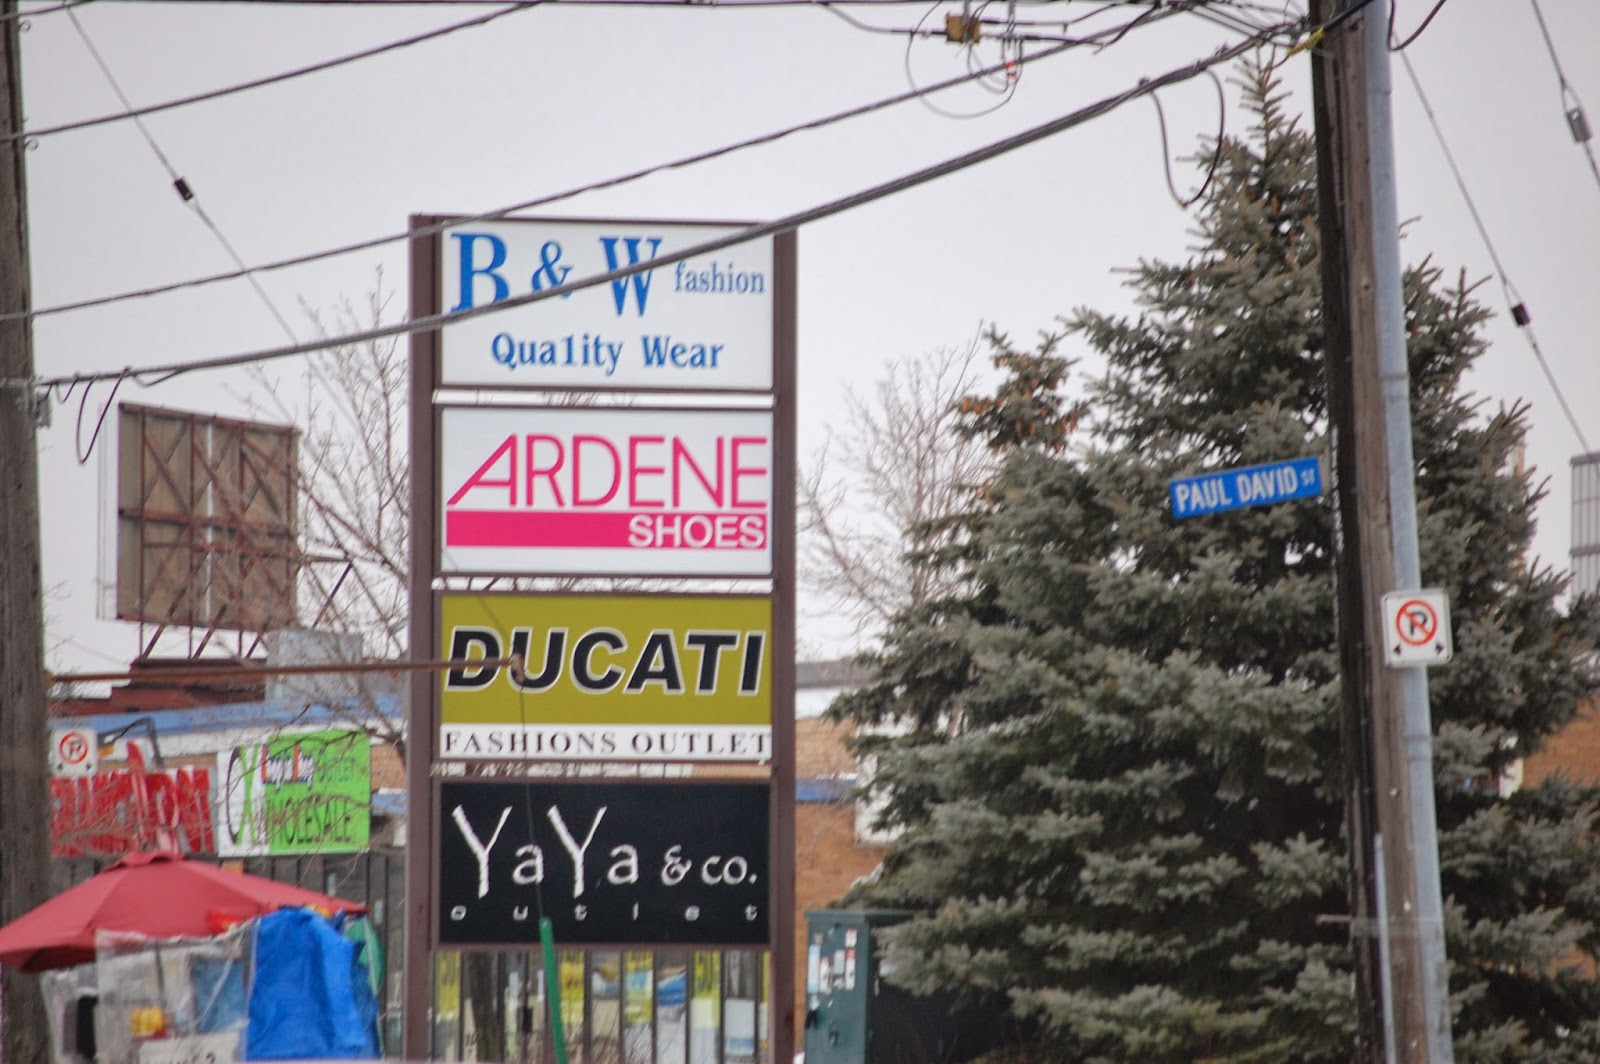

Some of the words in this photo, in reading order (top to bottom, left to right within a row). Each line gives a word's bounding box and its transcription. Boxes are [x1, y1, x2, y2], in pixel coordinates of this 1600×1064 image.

[451, 233, 510, 315] B
[530, 240, 573, 299] &
[599, 237, 662, 317] W
[674, 260, 765, 294] fashion
[641, 336, 723, 368] Wear
[447, 434, 767, 508] ARDENE
[1175, 480, 1232, 512] PAUL
[1236, 466, 1299, 500] DAVID
[628, 514, 765, 548] SHOES
[445, 626, 765, 696] DUCATI
[445, 731, 616, 754] FASHIONS
[631, 733, 769, 755] OUTLET
[452, 804, 640, 899] YaYa
[661, 844, 693, 886] &
